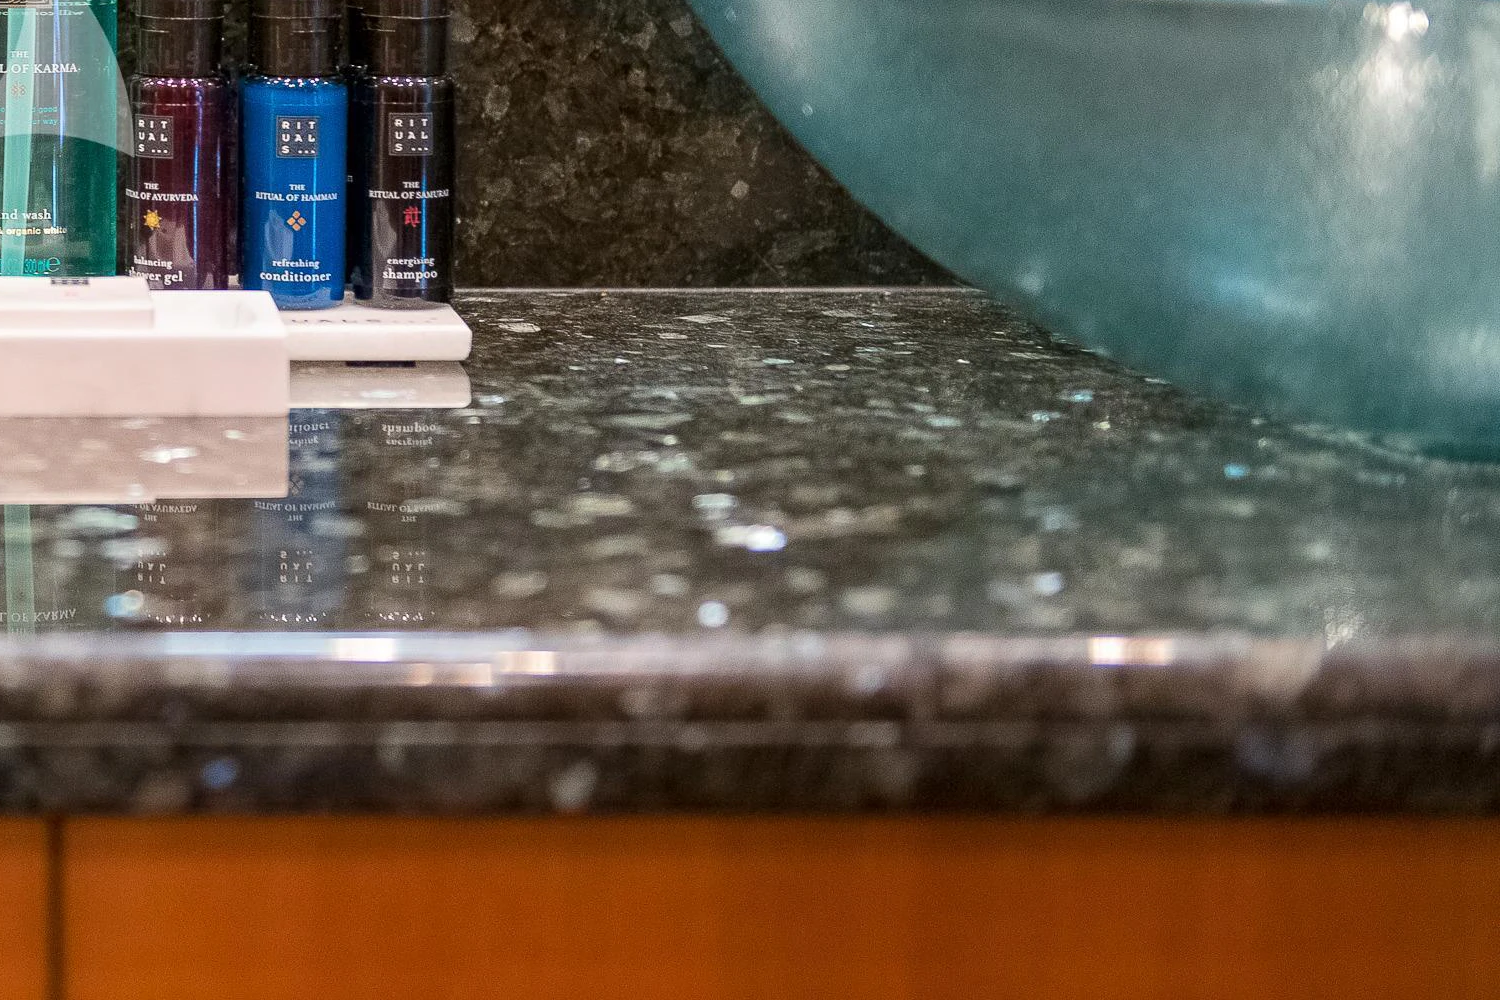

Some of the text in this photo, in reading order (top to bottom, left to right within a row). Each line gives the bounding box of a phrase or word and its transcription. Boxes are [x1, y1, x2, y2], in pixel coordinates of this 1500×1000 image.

[11, 64, 29, 74] OF
[282, 121, 316, 130] RIT
[394, 119, 428, 127] RIT
[282, 134, 316, 143] UAL
[394, 131, 428, 140] UAL
[144, 182, 160, 190] THE
[140, 192, 151, 200] OF
[151, 193, 198, 202] AYURVEDA
[255, 192, 338, 202] RITUAL OF HAMMAM
[368, 190, 400, 199] RITUAL
[401, 191, 414, 199] OF
[23, 208, 52, 220] wash
[6, 226, 41, 236] organic
[43, 225, 68, 235] white
[134, 255, 173, 270] balancing
[272, 258, 320, 270] refreshing
[387, 256, 435, 267] energising
[164, 270, 183, 286] gel
[260, 270, 332, 282] conditioner
[382, 268, 438, 283] shampoo
